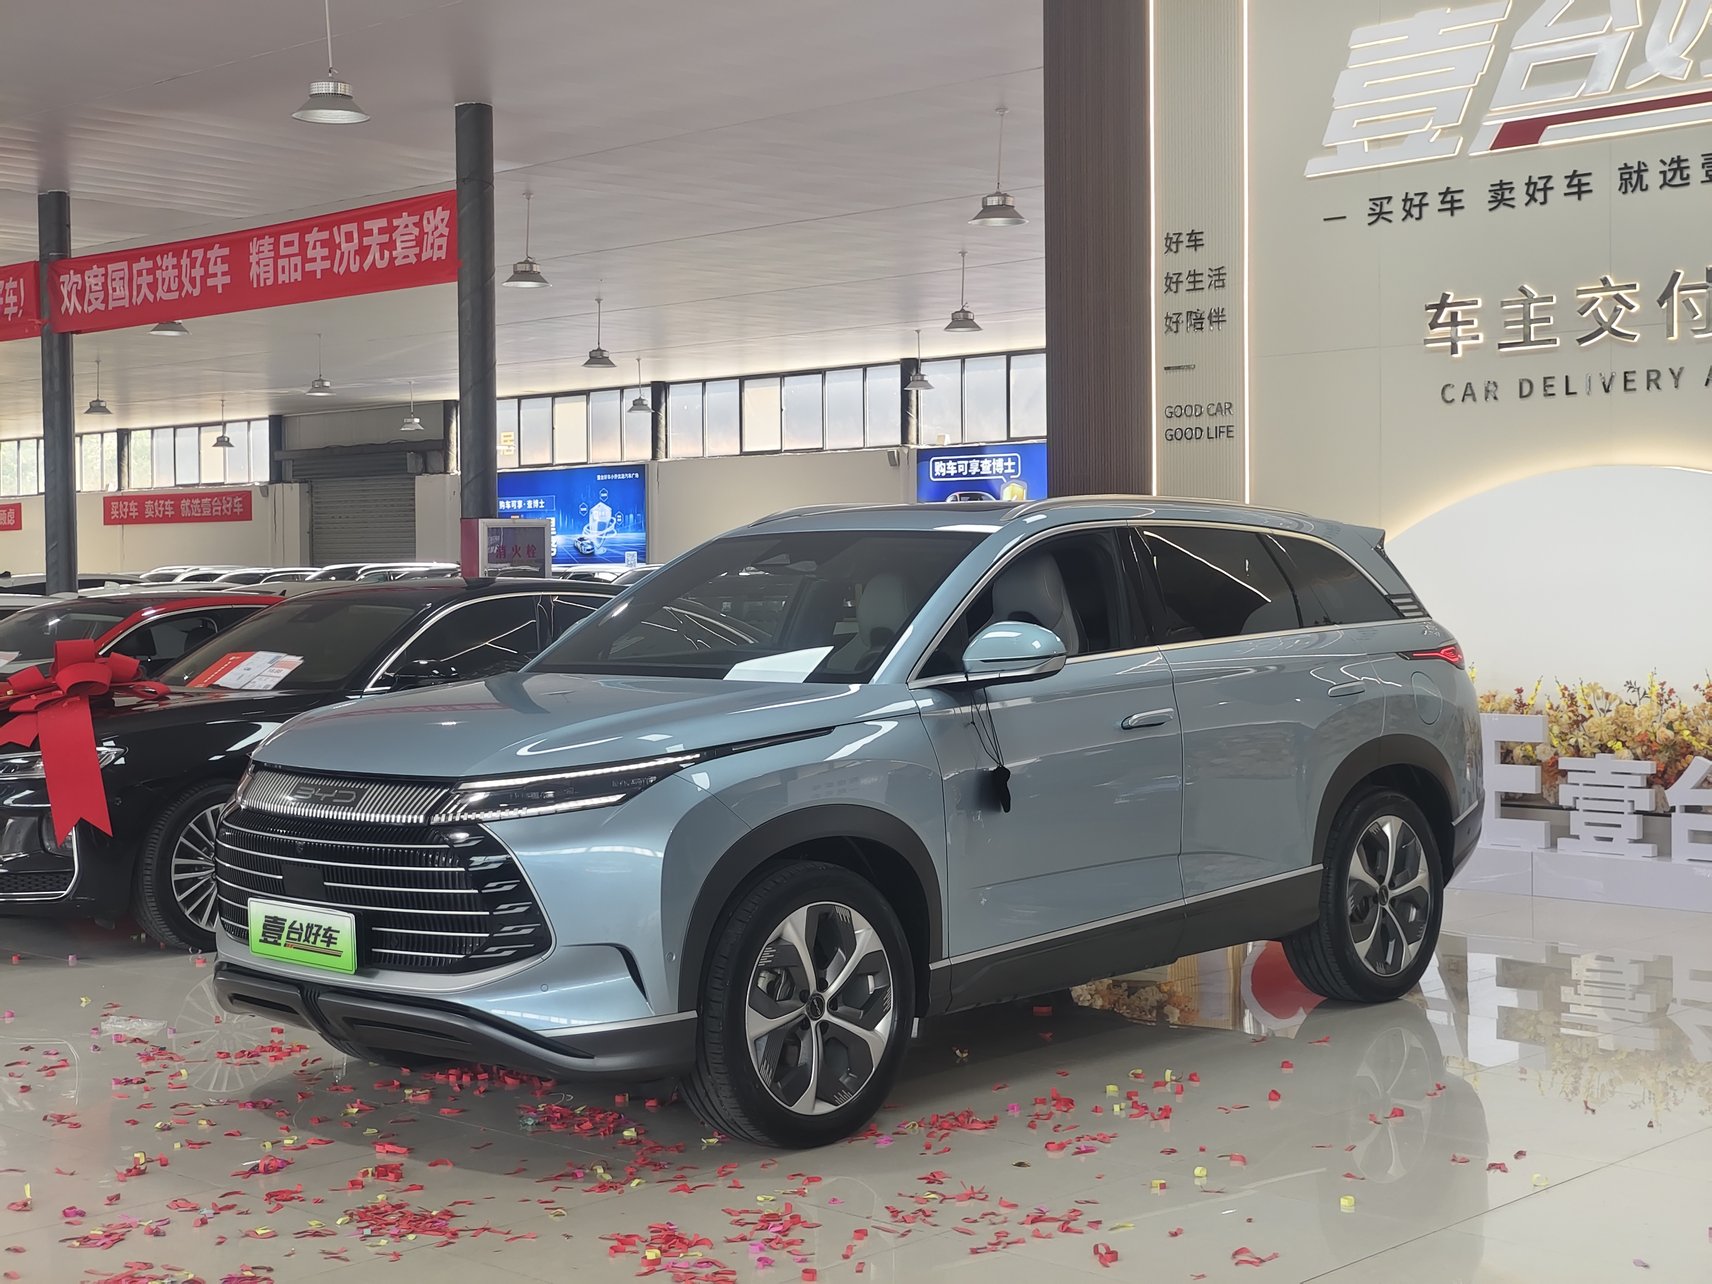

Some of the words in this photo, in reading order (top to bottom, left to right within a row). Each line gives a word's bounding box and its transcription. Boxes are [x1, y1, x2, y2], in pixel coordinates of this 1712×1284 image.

[1367, 186, 1465, 226] 买好车
[1487, 169, 1593, 212] 卖好车
[1164, 229, 1205, 254] 好车
[59, 243, 232, 316] 欢度国庆选好车
[248, 206, 452, 289] 精品车况无套路
[1164, 266, 1227, 294] 好生活
[1164, 307, 1227, 335] 好陪伴
[1423, 265, 1712, 357] 车主交付
[1440, 379, 1499, 404] CAR
[1518, 366, 1685, 400] DELIVERY
[1164, 403, 1204, 419] GOOD
[1206, 401, 1234, 417] CAR
[1164, 426, 1204, 442] GOOD
[1206, 424, 1235, 439] LIFE
[934, 458, 1016, 476] 购车可享查博士
[110, 501, 139, 520] 买好车
[145, 499, 175, 518] 卖好车
[180, 496, 244, 518] 就选壹台好车
[496, 544, 537, 559] 消火栓
[293, 785, 357, 804] BYD
[258, 914, 341, 949] 壹台好车
